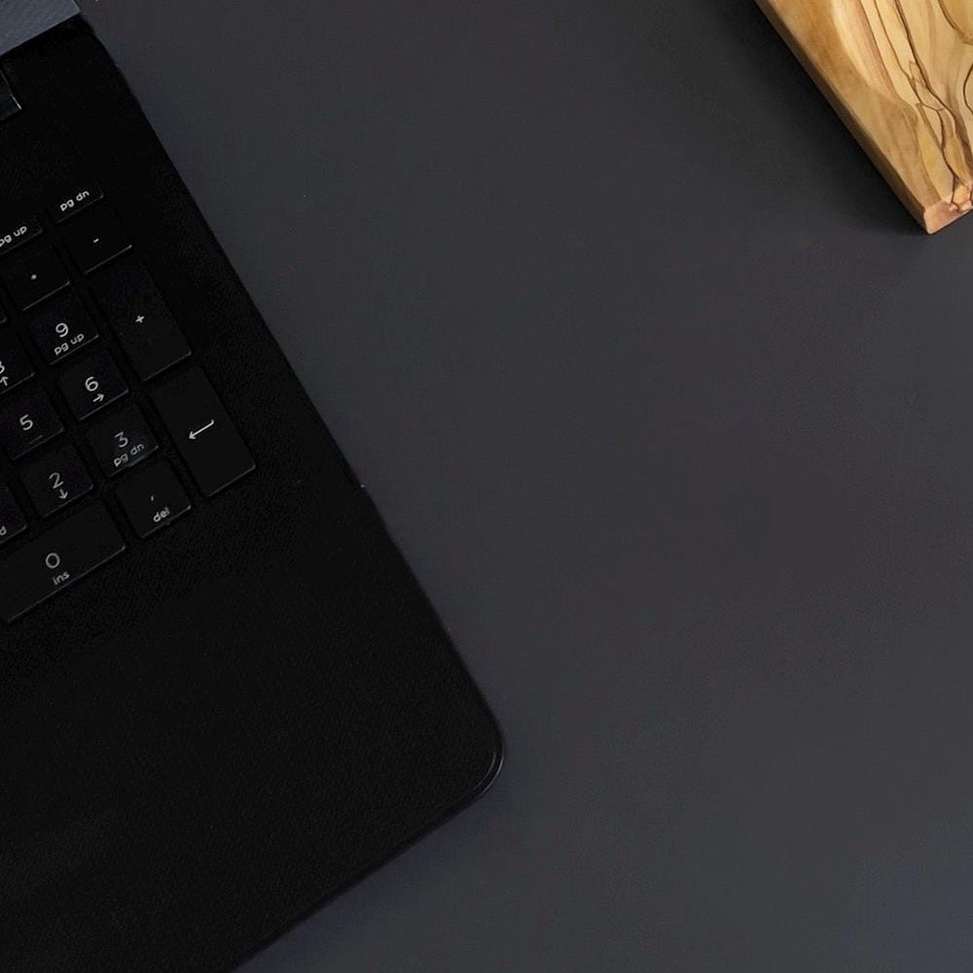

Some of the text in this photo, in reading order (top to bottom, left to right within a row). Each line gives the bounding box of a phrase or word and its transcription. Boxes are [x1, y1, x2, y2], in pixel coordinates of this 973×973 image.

[60, 190, 90, 212] pg dn
[13, 226, 28, 237] up
[55, 322, 69, 338] 9
[53, 333, 85, 356] pg up
[84, 376, 99, 393] 6
[19, 414, 34, 431] 5
[114, 431, 129, 448] 3
[113, 443, 145, 467] pg dn
[48, 472, 64, 489] 2
[152, 506, 171, 523] del
[45, 552, 61, 569] 0
[52, 571, 71, 586] ins
